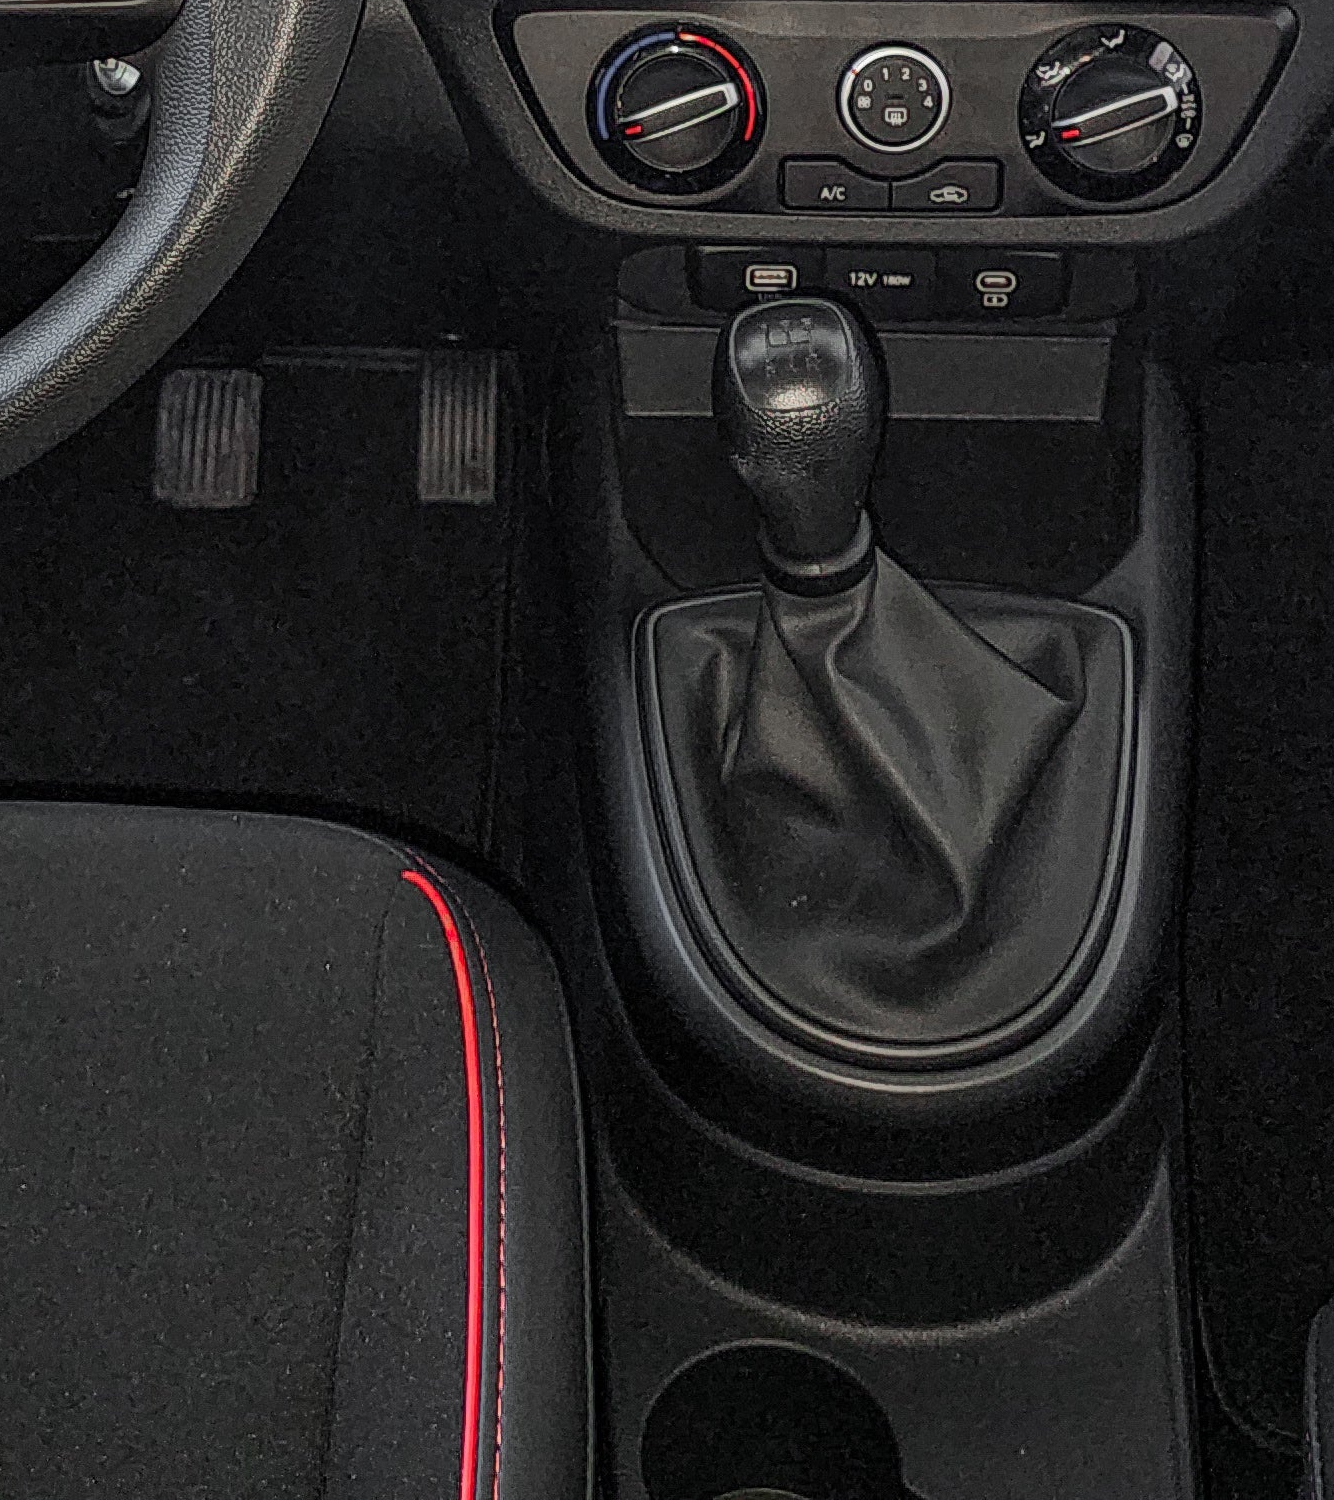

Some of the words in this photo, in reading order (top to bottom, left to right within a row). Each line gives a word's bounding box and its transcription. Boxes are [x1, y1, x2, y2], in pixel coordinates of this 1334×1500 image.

[882, 66, 889, 81] 1
[900, 66, 911, 81] 2
[863, 79, 873, 93] 0
[917, 79, 928, 93] 3
[922, 95, 934, 109] 4
[819, 185, 847, 201] A/C
[848, 271, 878, 287] 12V
